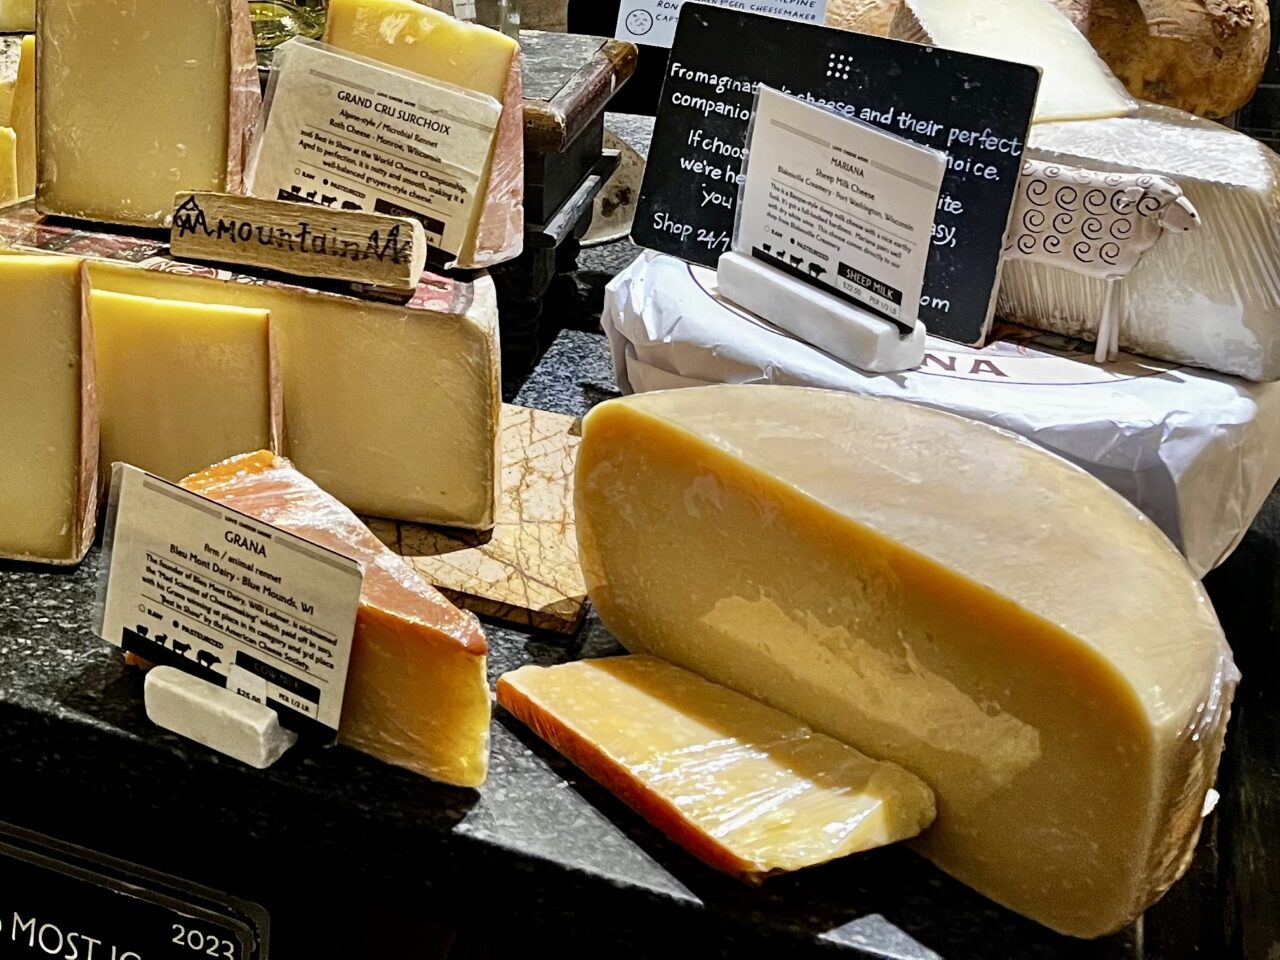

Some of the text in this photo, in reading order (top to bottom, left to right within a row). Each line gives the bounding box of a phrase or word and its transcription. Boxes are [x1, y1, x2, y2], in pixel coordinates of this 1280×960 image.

[657, 0, 678, 10] RON
[750, 4, 816, 21] CHEESEMAKER
[337, 91, 451, 135] GRAND CRU SURCHOIX
[671, 91, 751, 121] companio
[329, 119, 442, 164] Roth Cheese Monroe, Wisconsin
[688, 129, 701, 145] If
[859, 107, 892, 125] and
[896, 112, 944, 135] their
[947, 127, 1023, 156] perfect
[680, 156, 722, 180] we're
[830, 158, 865, 178] MARIANA
[700, 183, 733, 209] you
[815, 168, 875, 200] Sheep Milk Cheese
[653, 212, 693, 237] Shop
[845, 268, 894, 301] SHEEP MILK
[224, 530, 267, 558] GRANA
[170, 543, 314, 616] Bleu Mont Dairy Blue Mounds, WI
[11, 910, 100, 959] MOST
[172, 924, 234, 960] 2023
